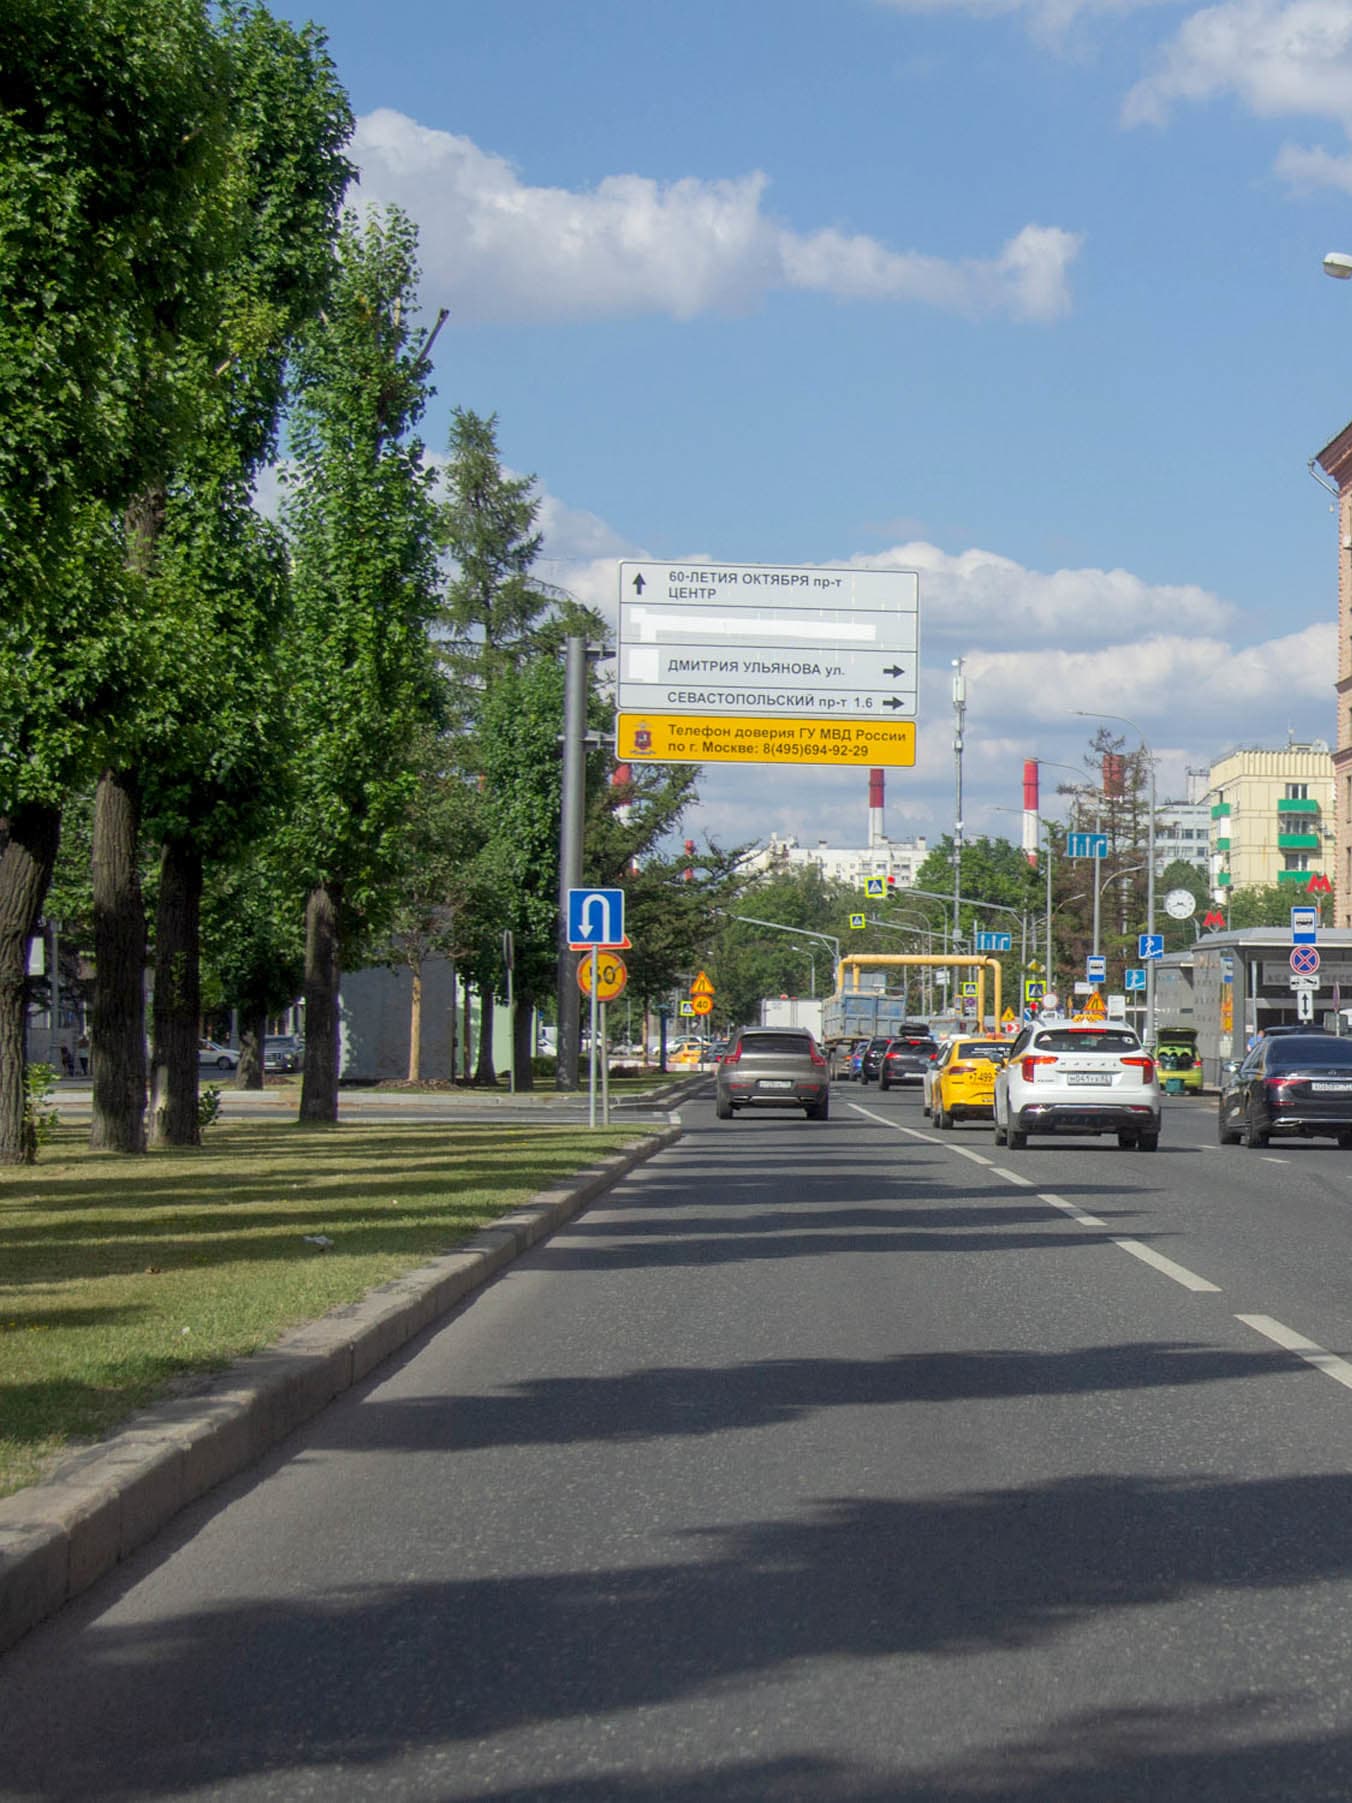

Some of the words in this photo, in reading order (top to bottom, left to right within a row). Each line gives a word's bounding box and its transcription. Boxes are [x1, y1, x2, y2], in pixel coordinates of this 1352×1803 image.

[669, 571, 738, 584] 60-ЛЕТИЯ
[742, 573, 809, 587] ОКТЯБРЯ
[814, 577, 843, 589] пр-т
[668, 587, 717, 600] ЦЕНТР
[667, 659, 739, 673] ДМИТРИЯ
[743, 662, 821, 675] УЛЬЯНОВА
[825, 666, 845, 678] ул.
[667, 691, 815, 707] СЕВАСТОПОЛЬСКИЙ
[819, 698, 848, 709] пр-т
[855, 697, 873, 708] 1.6
[668, 724, 731, 738] Телефон
[735, 728, 795, 740] доверия
[799, 728, 816, 739] ГУ
[820, 729, 851, 741] МВД
[856, 730, 907, 742] России
[668, 742, 686, 752] по
[689, 743, 698, 752] г.
[702, 741, 759, 754] Москве:
[763, 743, 869, 758] 8(495)694-92-29
